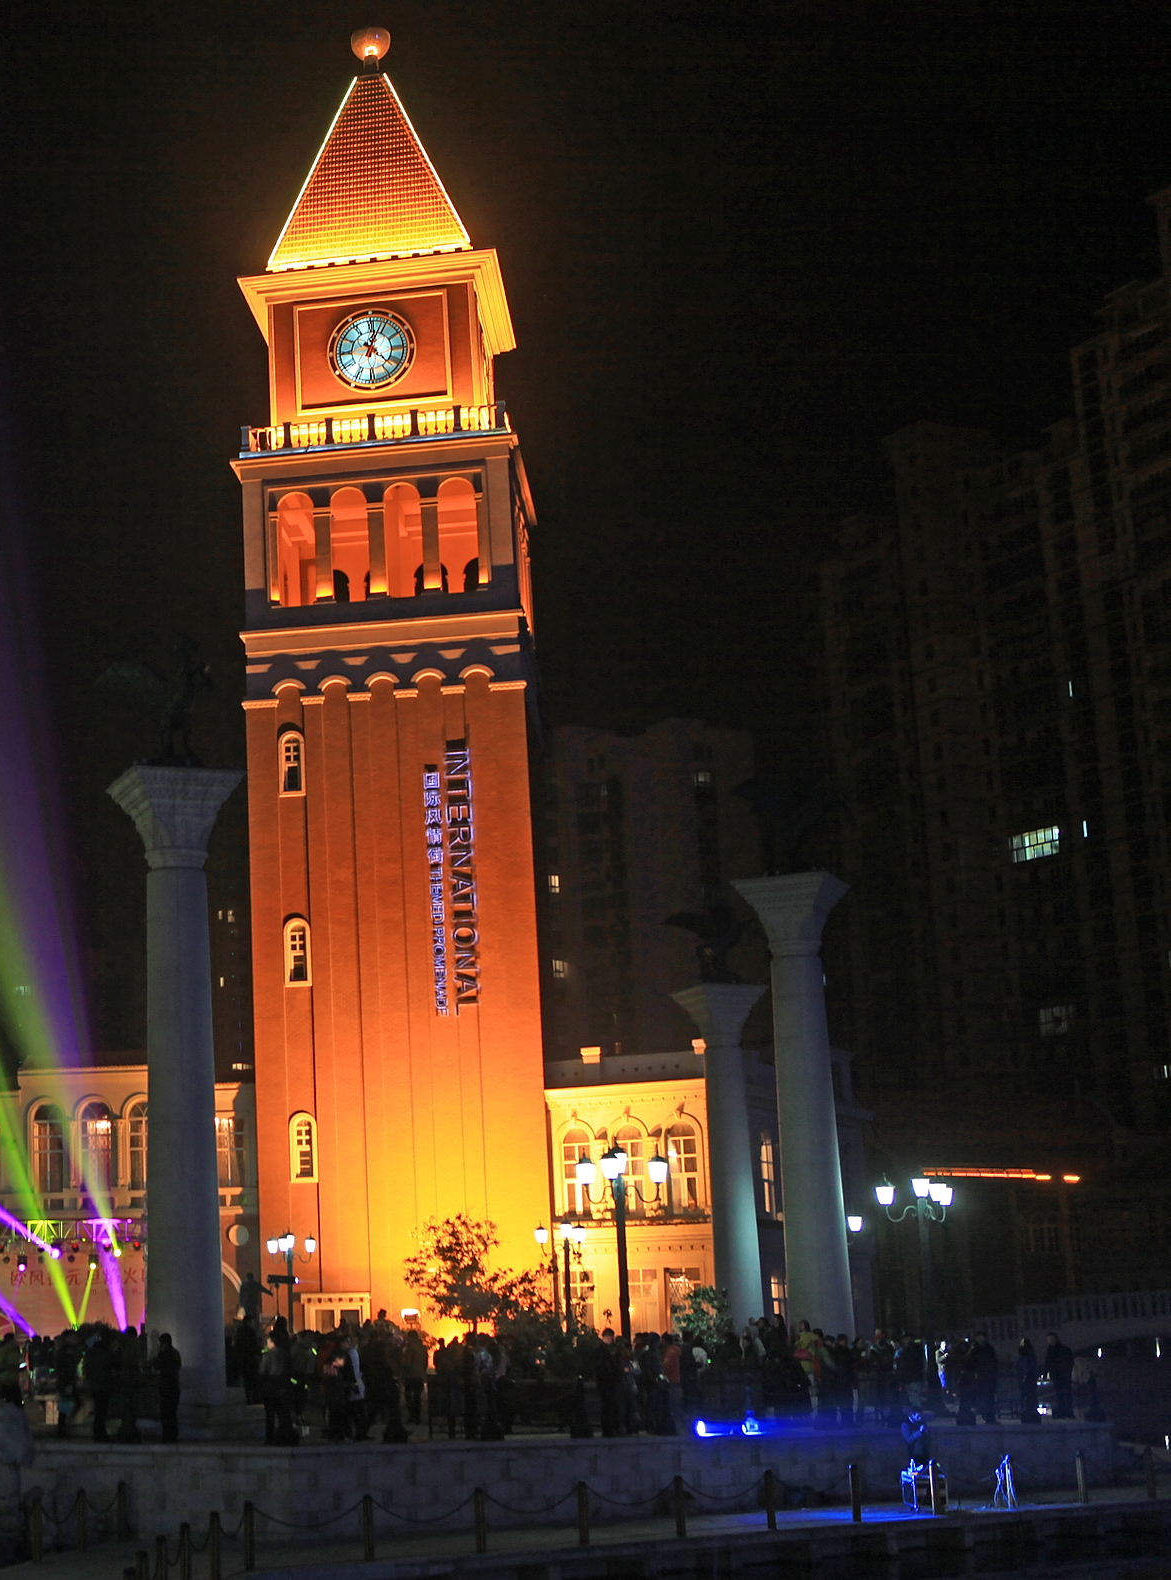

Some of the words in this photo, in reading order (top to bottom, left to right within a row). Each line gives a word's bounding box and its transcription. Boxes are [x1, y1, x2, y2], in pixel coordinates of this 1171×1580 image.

[423, 772, 444, 865] 国际风情街
[429, 866, 445, 924] THEMED
[444, 749, 481, 1015] INTERNATIONAL
[432, 926, 449, 1017] PROMENADE
